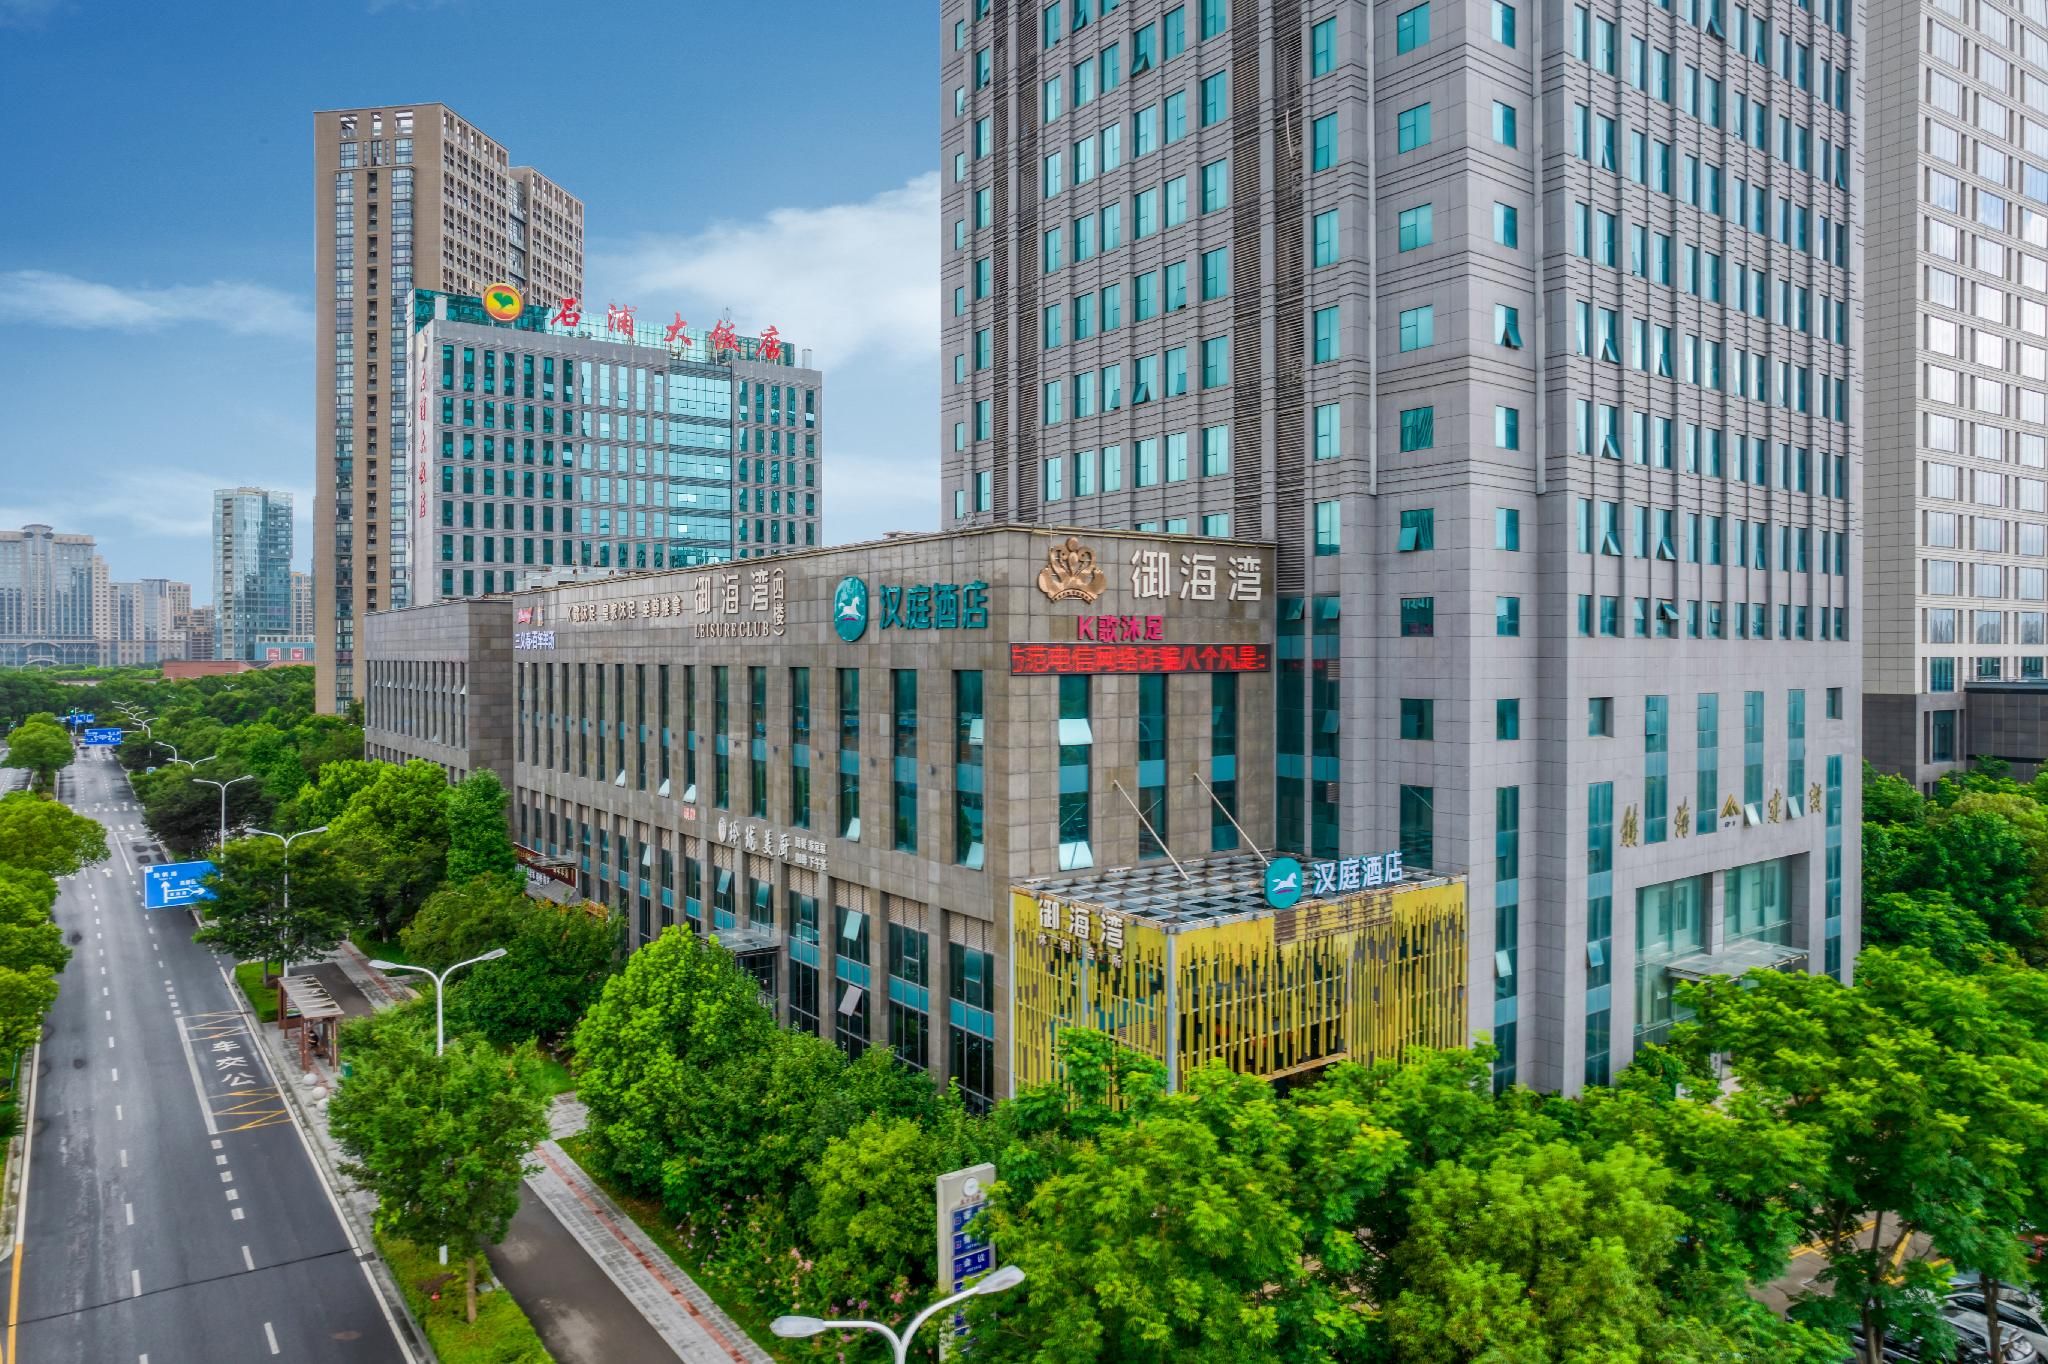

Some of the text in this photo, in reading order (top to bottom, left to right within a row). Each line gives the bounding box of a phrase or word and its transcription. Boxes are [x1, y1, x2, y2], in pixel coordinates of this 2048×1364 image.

[550, 297, 782, 360] 石浦大饭店
[695, 569, 770, 615] 御海湾
[1130, 549, 1263, 601] 御海湾
[879, 580, 989, 630] 汉庭酒店
[1077, 614, 1165, 642] K歌沐足
[695, 621, 770, 639] LEISURE CLUB
[1312, 850, 1404, 896] 汉庭酒店
[1038, 898, 1124, 950] 御海湾
